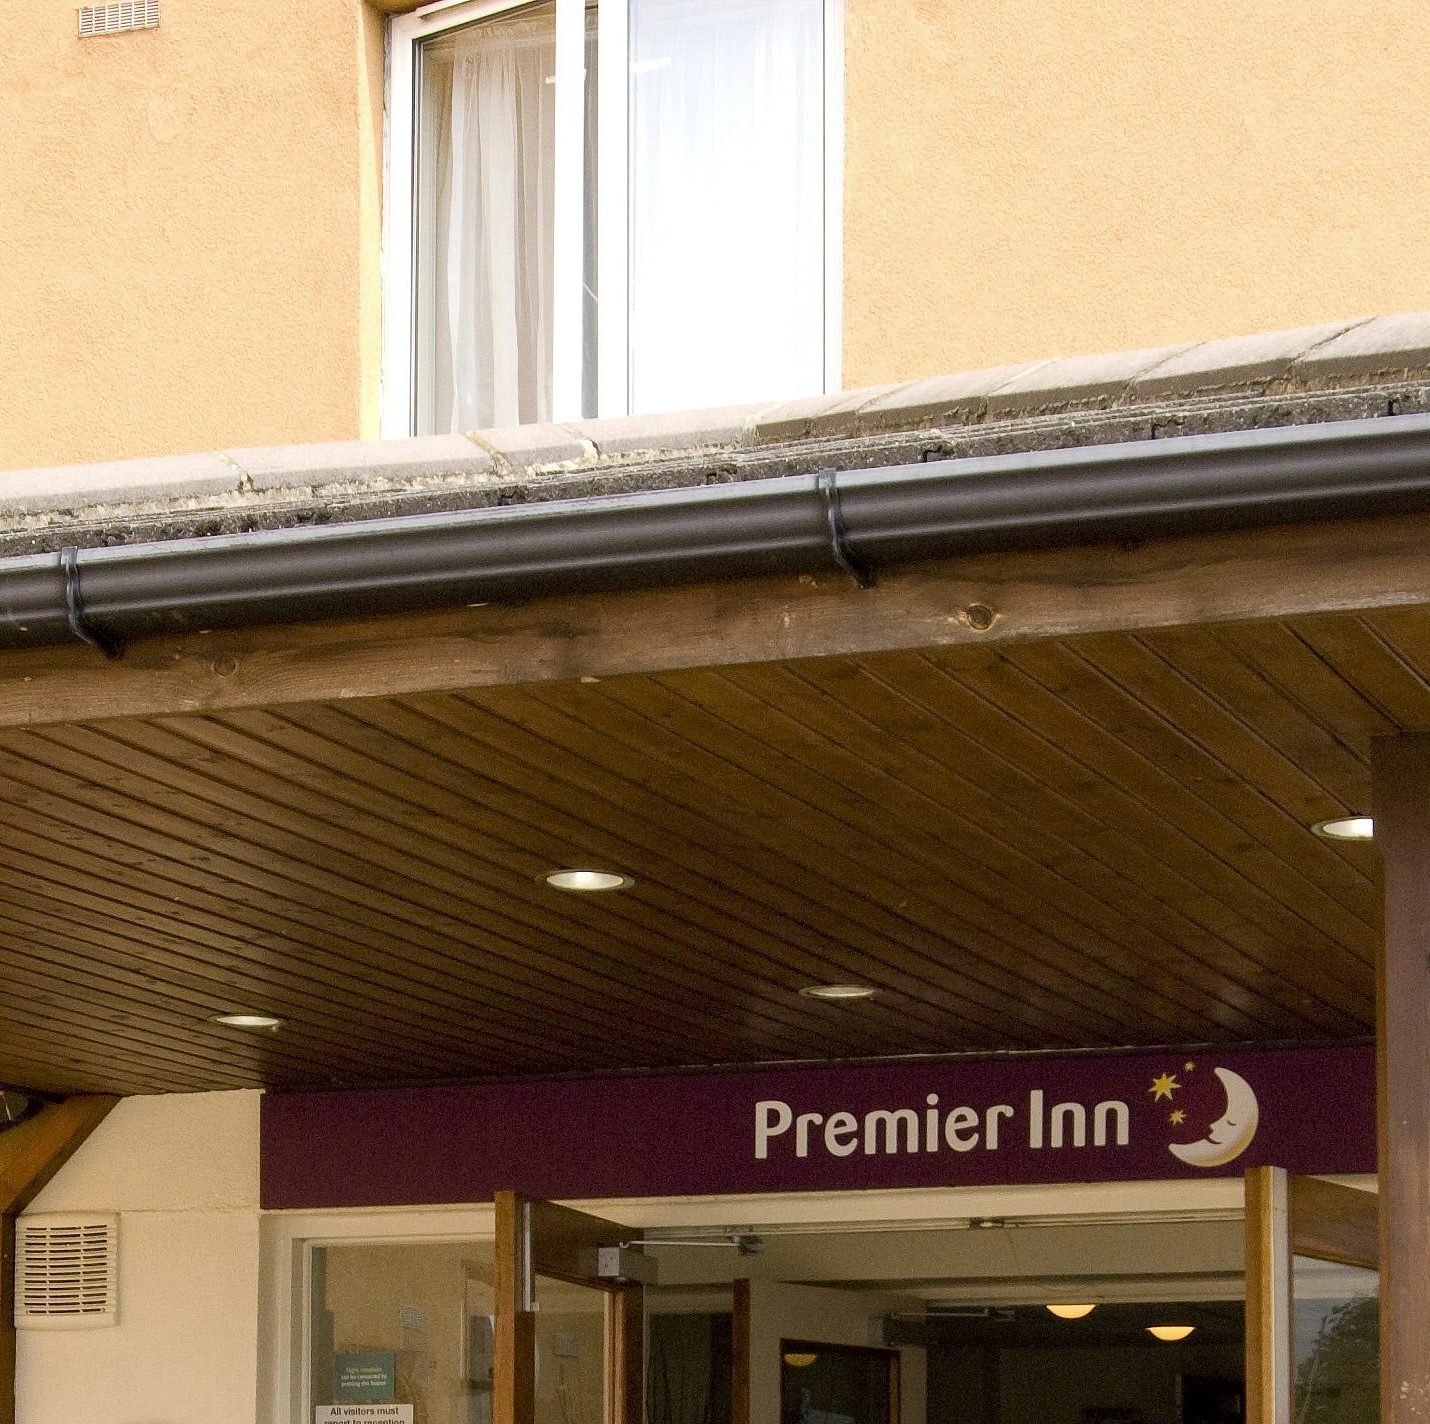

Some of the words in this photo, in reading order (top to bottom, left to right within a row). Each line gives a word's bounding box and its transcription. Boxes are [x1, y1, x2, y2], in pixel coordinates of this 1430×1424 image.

[755, 1093, 1014, 1159] Premier
[1029, 1089, 1130, 1148] Inn
[330, 1407, 341, 1416] All
[343, 1406, 375, 1416] visitors
[377, 1406, 399, 1415] must
